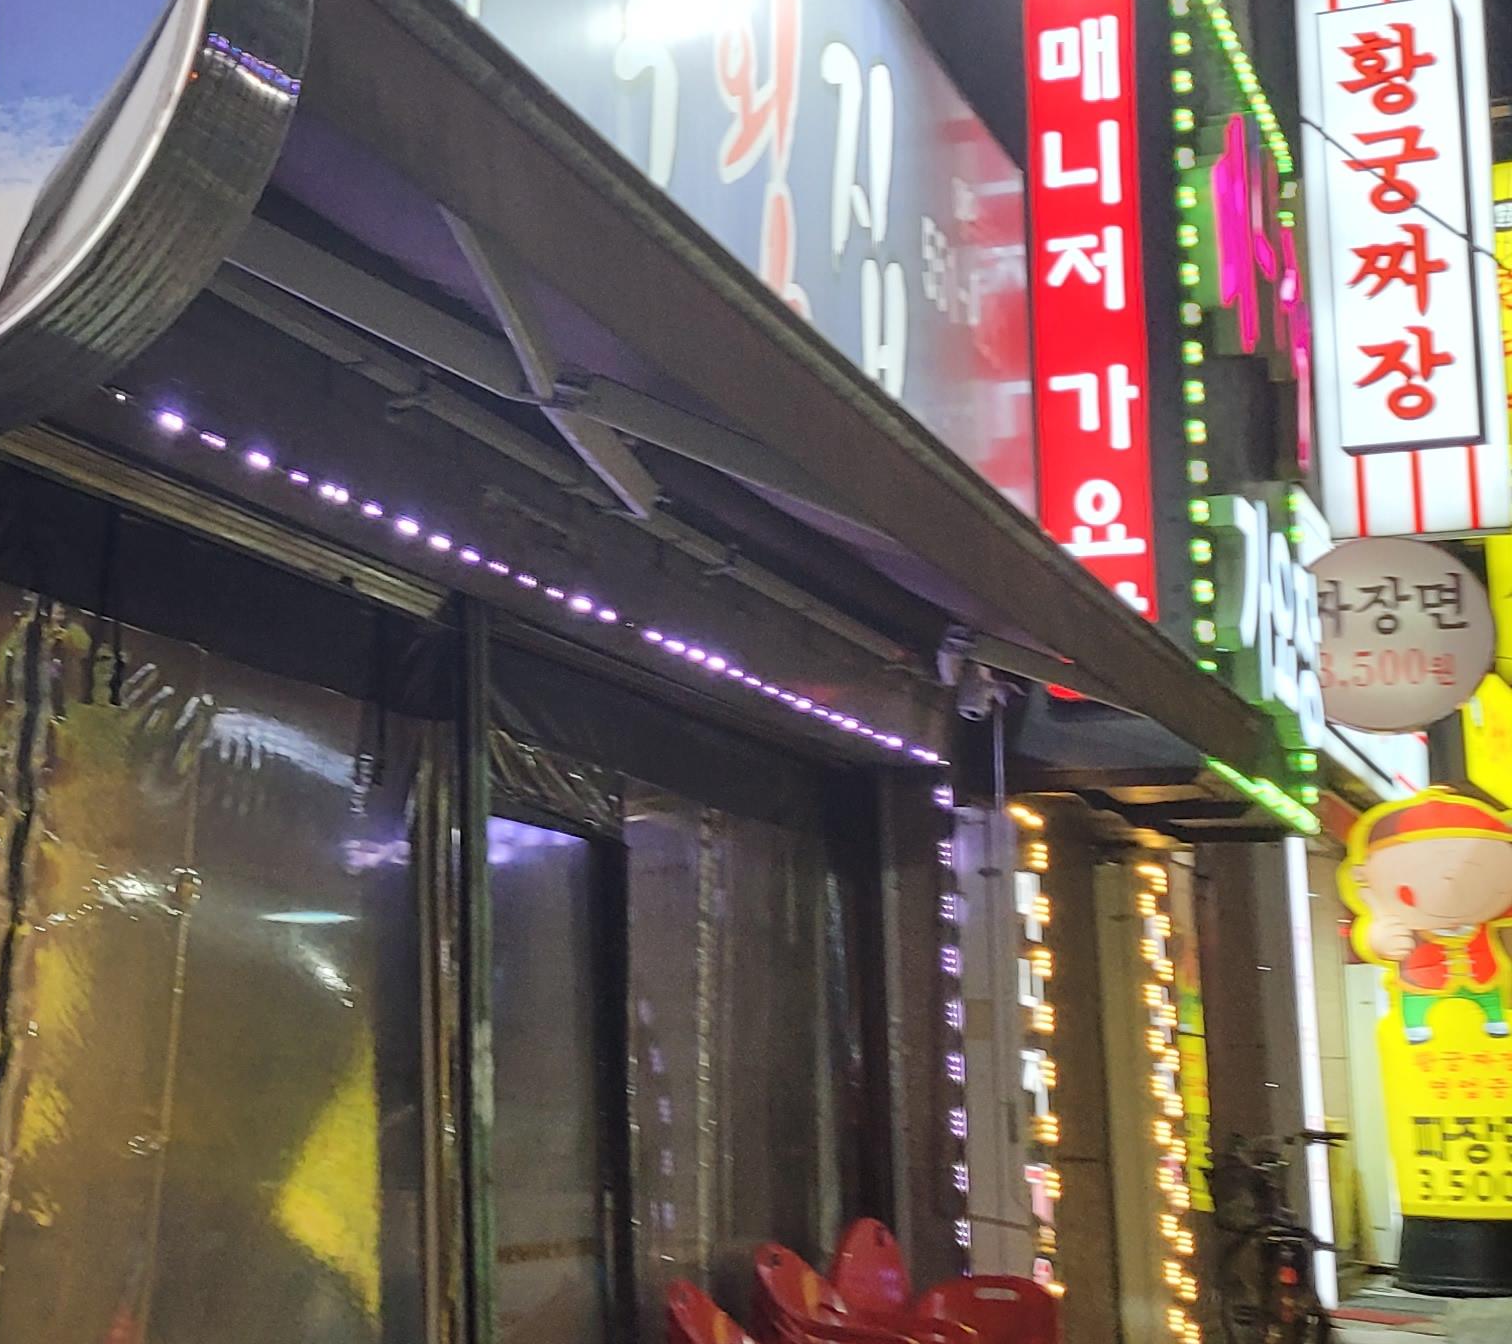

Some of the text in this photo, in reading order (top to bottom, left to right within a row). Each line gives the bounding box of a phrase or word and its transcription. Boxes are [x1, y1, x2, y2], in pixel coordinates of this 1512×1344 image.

[1038, 13, 1149, 613] 매니저 가요
[1337, 22, 1455, 421] 황궁짜장
